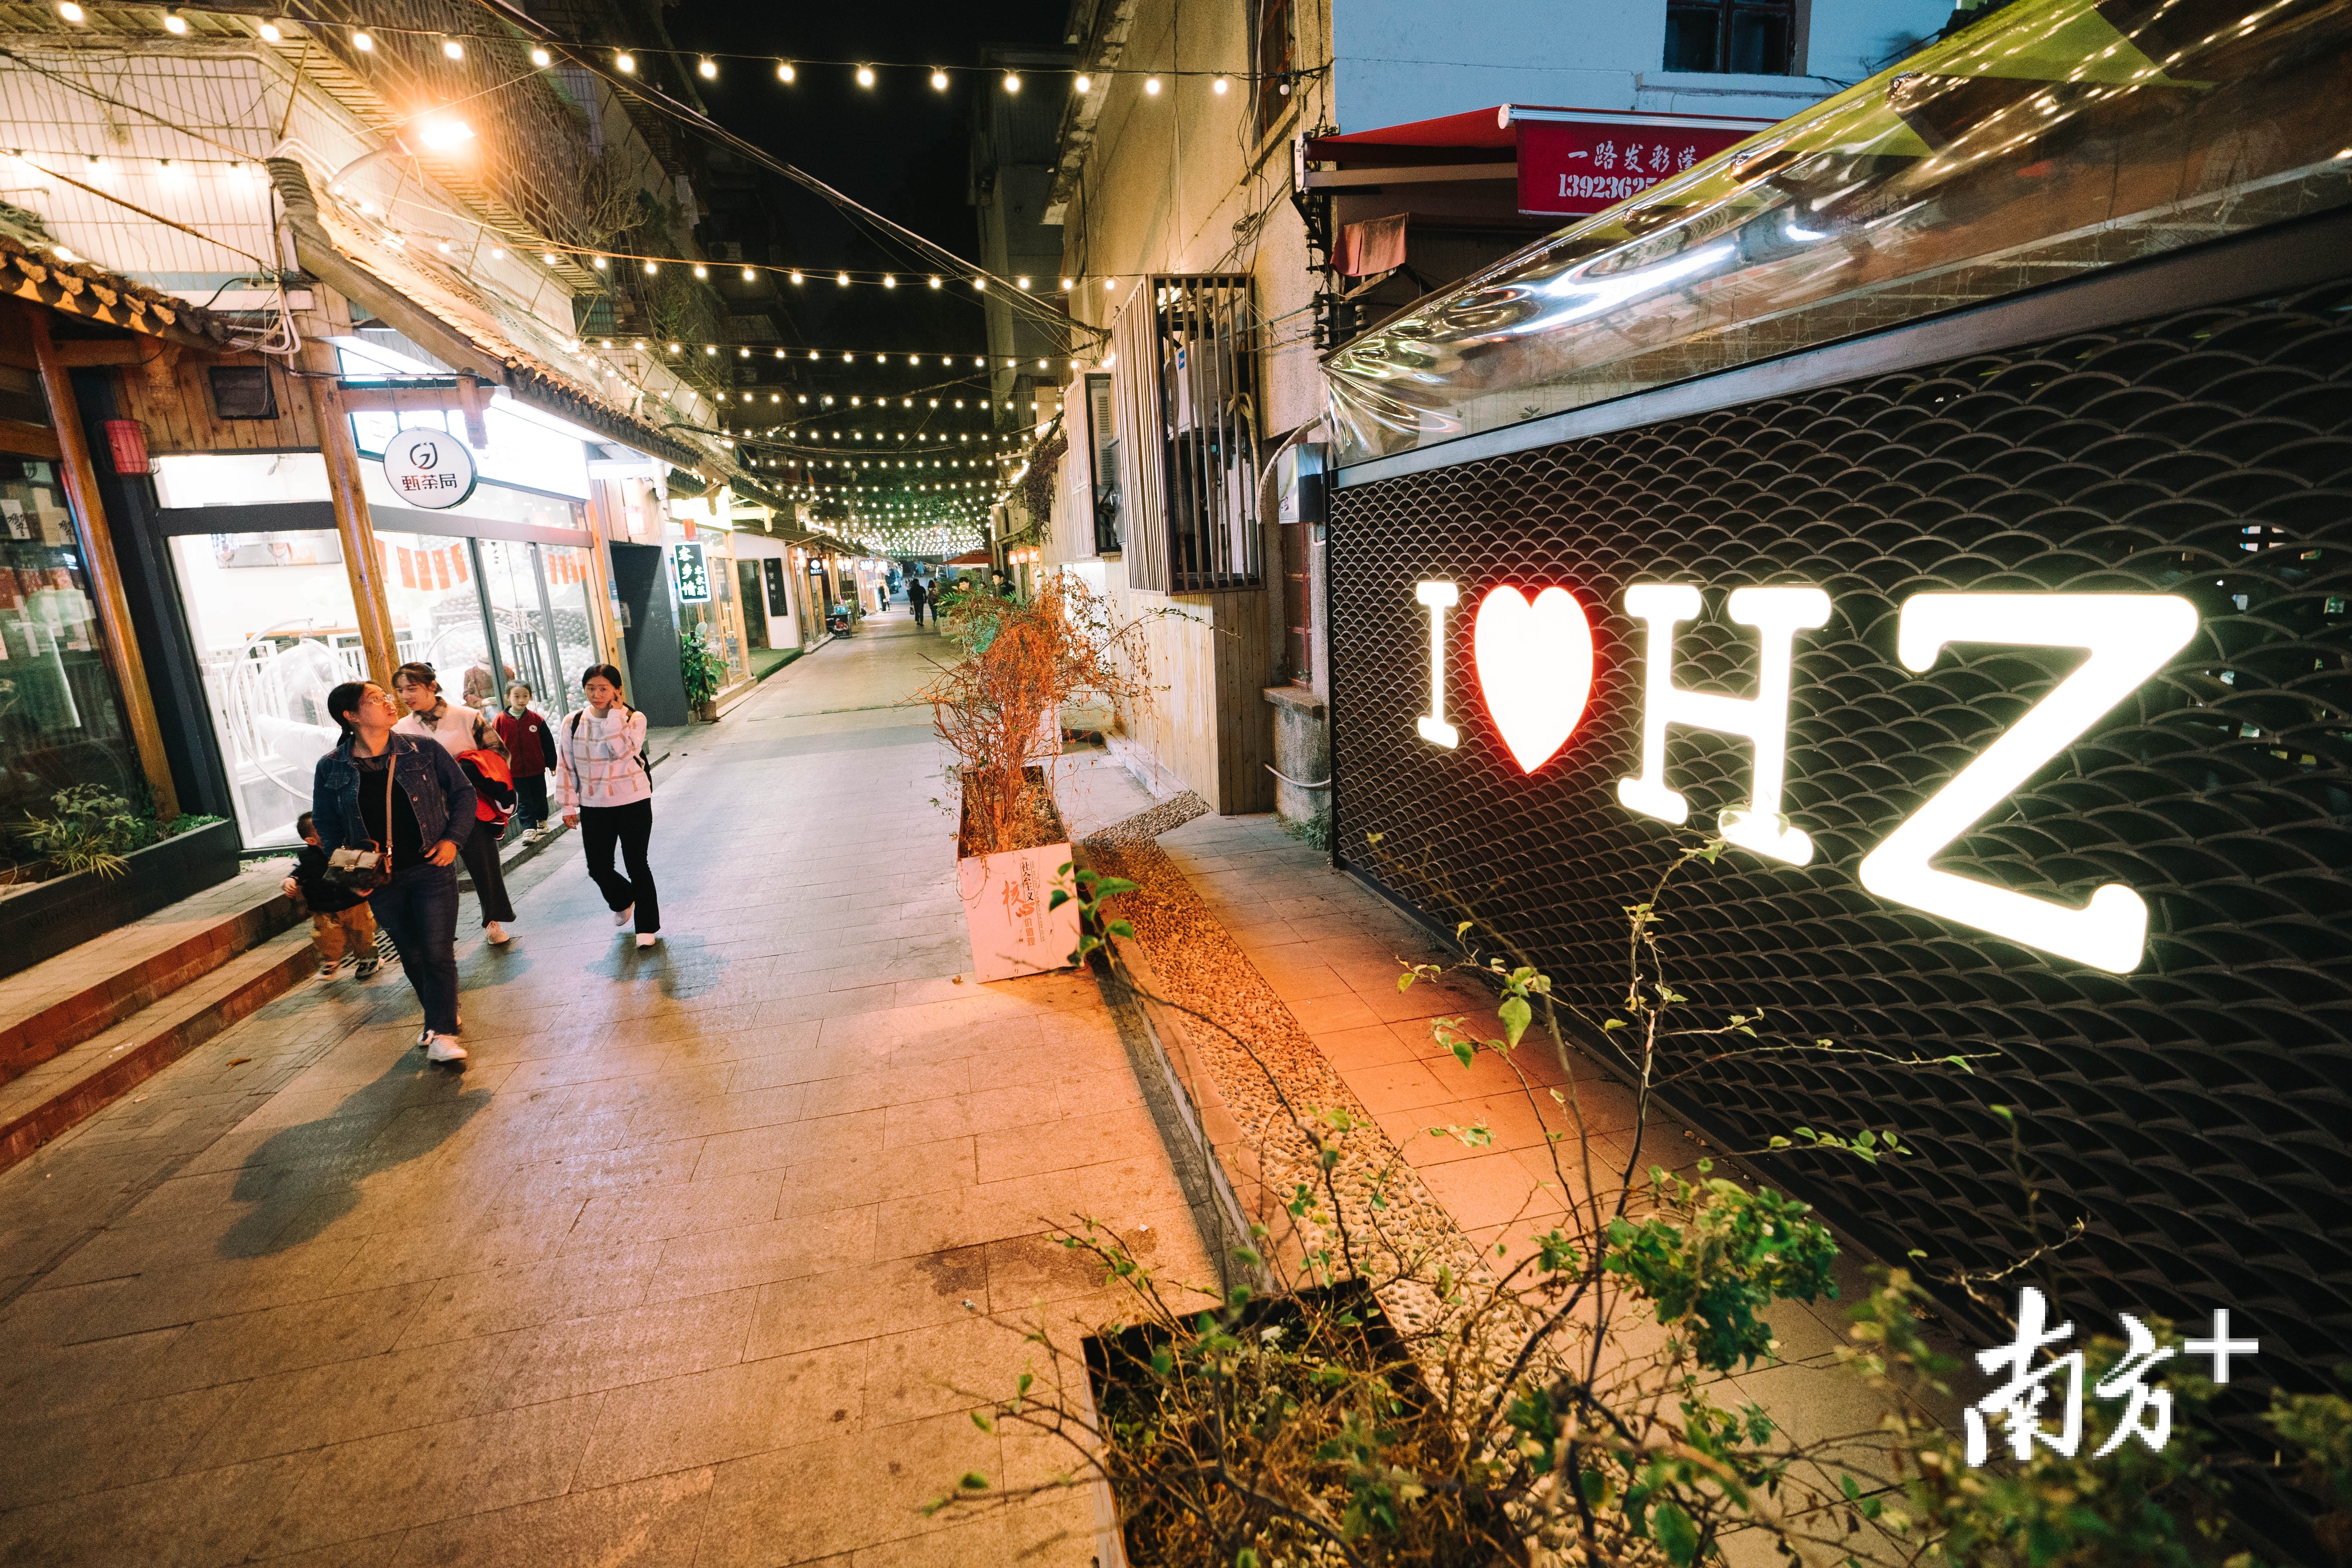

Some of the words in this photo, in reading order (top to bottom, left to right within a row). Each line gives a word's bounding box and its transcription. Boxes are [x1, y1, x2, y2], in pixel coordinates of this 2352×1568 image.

[1416, 582, 1459, 749] I
[1617, 584, 2200, 975] HZ
[1022, 862, 1034, 902] 社会主义
[1024, 918, 1035, 946] 价值观
